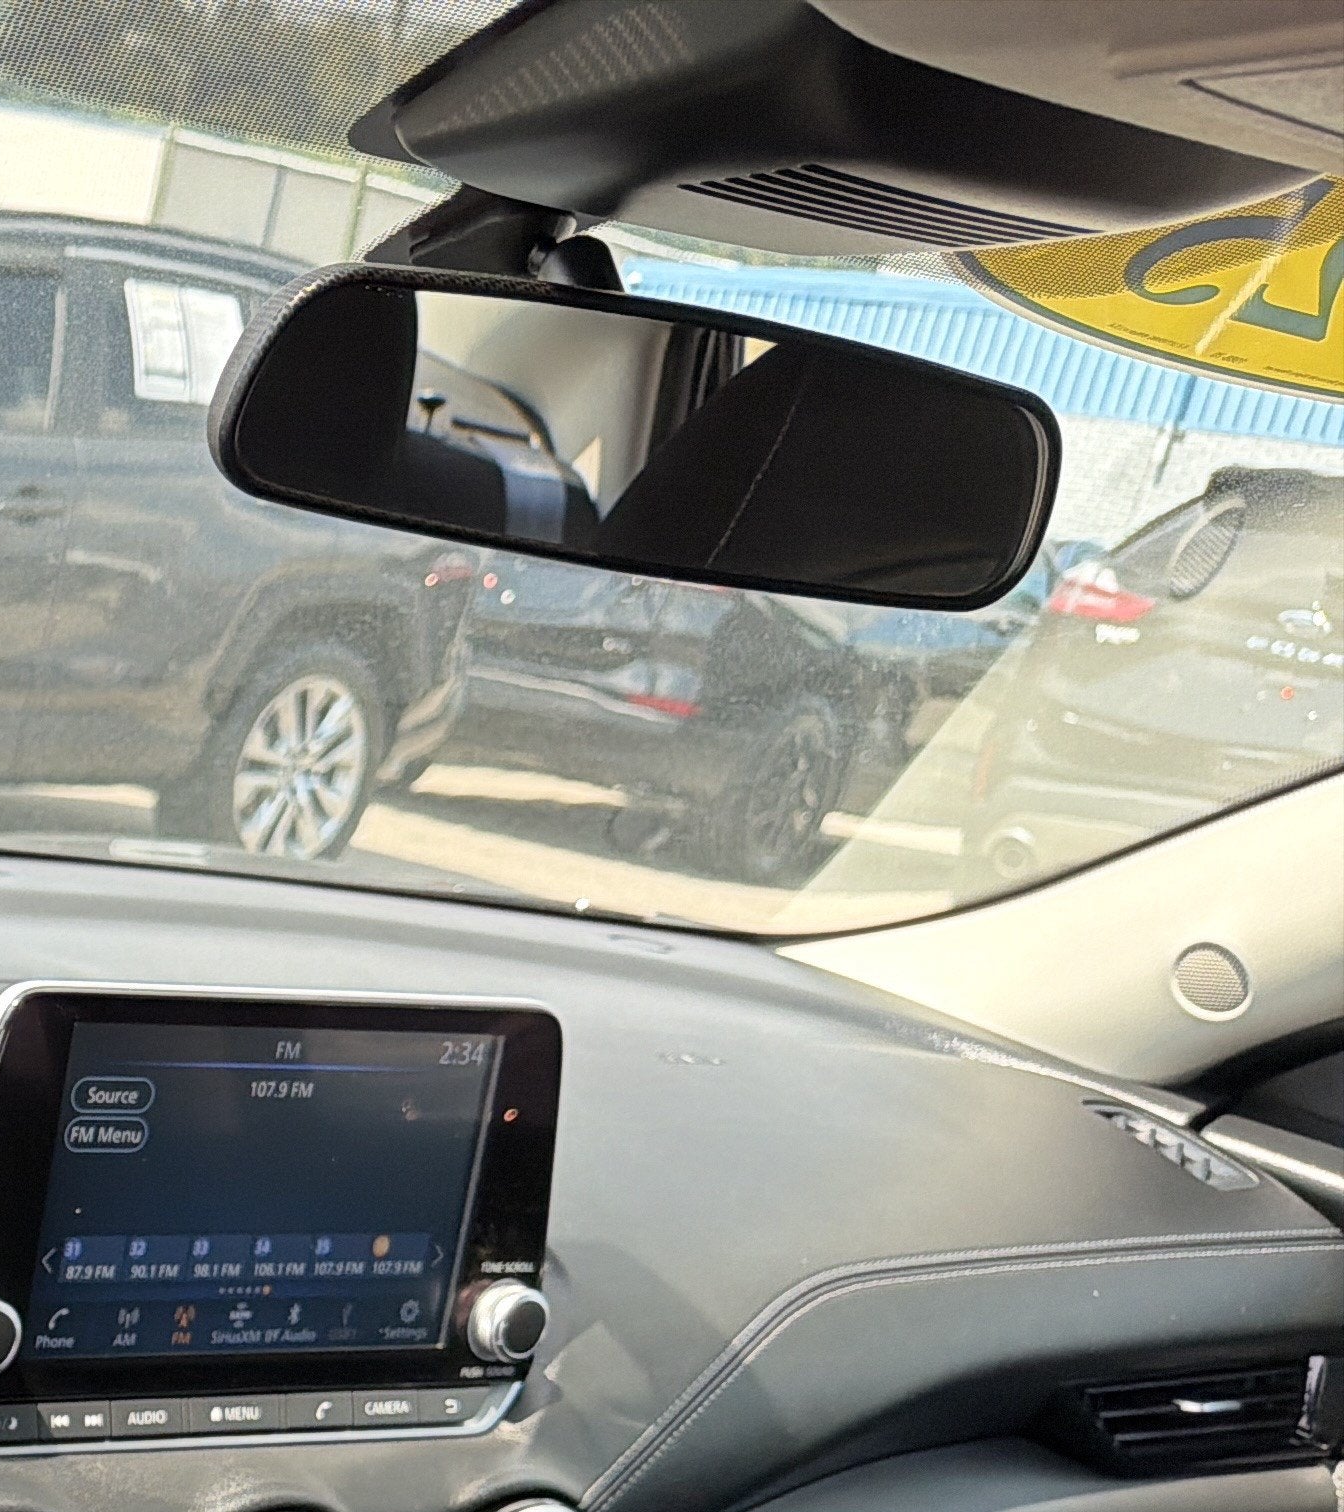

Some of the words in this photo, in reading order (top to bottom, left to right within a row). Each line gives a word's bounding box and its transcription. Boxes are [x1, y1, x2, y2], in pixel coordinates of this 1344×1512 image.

[275, 1041, 301, 1060] FM
[439, 1040, 484, 1066] 2:34
[86, 1087, 138, 1105] Source
[250, 1080, 288, 1098] 107.9
[290, 1082, 314, 1099] FM
[70, 1126, 94, 1144] FM
[97, 1127, 142, 1145] Menu
[94, 1264, 115, 1279] FM
[158, 1264, 180, 1278] FM
[220, 1263, 241, 1277] FM
[285, 1262, 306, 1276] FM
[35, 1334, 75, 1349] Phone
[224, 1405, 261, 1422] MENU
[364, 1400, 411, 1416] CAMERA
[127, 1409, 168, 1426] AUDIO
